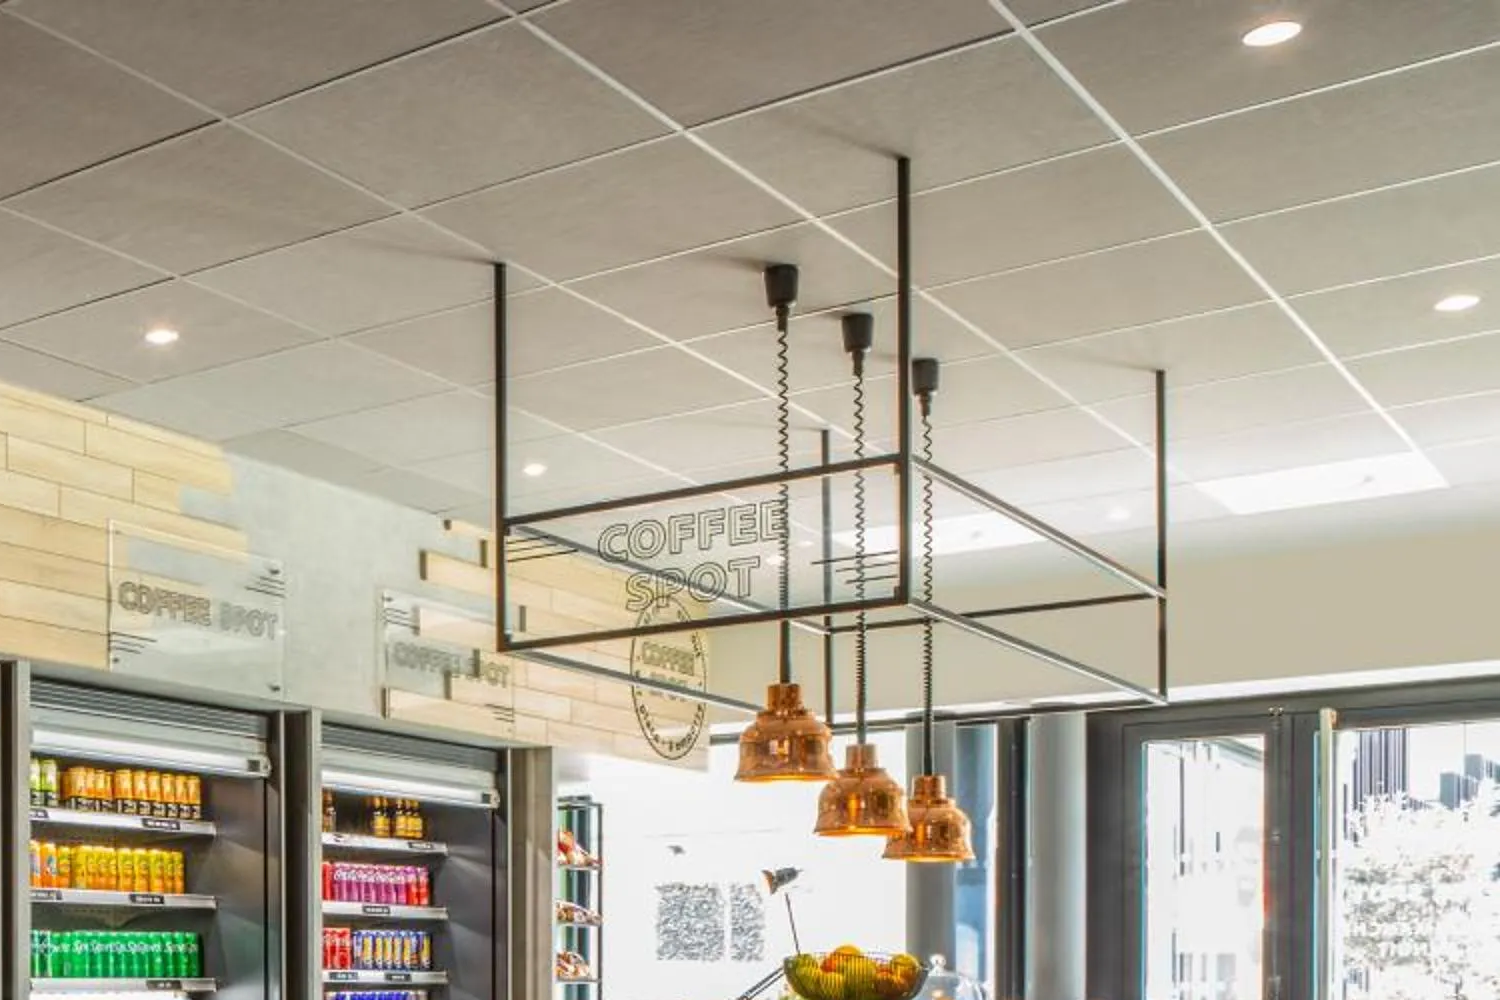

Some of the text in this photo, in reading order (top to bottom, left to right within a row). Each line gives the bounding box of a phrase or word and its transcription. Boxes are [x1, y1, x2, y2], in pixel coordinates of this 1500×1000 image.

[598, 499, 786, 562] COFFEE
[118, 581, 278, 641] COFFEE SPOT
[626, 555, 760, 612] SPOT
